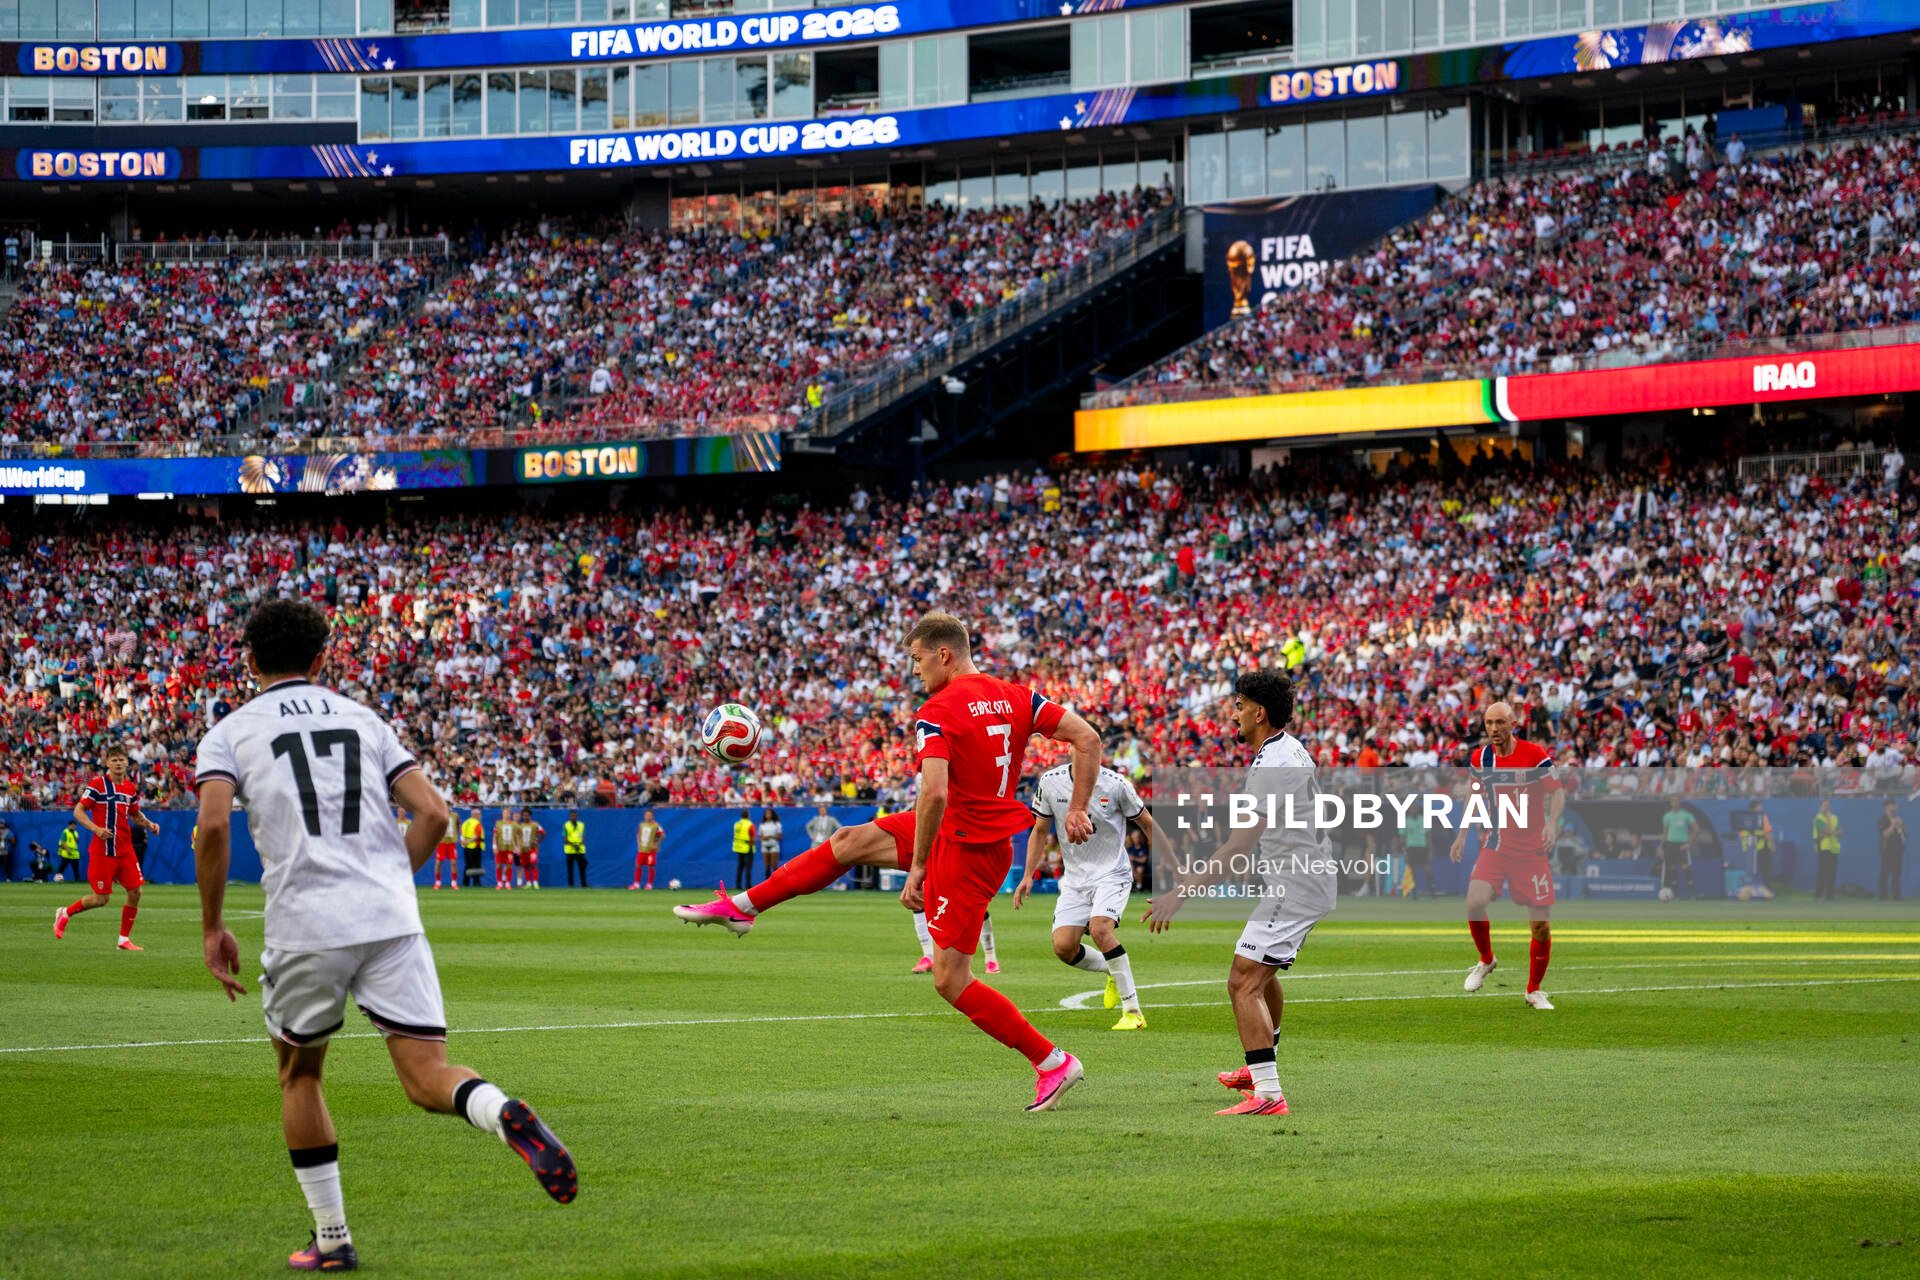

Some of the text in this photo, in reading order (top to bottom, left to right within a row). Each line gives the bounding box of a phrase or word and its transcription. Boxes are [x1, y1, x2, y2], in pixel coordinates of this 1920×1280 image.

[571, 5, 900, 57] FIFA WORLD CUP 2026
[34, 46, 166, 71] BOSTON
[1270, 61, 1398, 102] BOSTON
[570, 116, 900, 165] FIFA WORLD CUP 2026
[32, 152, 165, 177] BOSTON
[1261, 234, 1316, 262] FIFA
[1260, 259, 1343, 289] WOR
[1753, 361, 1816, 392] IRAQ
[523, 446, 637, 478] BOSTON
[280, 699, 338, 717] ALI J.
[986, 724, 1012, 798] 7
[271, 728, 362, 837] 17
[1531, 873, 1550, 894] 14
